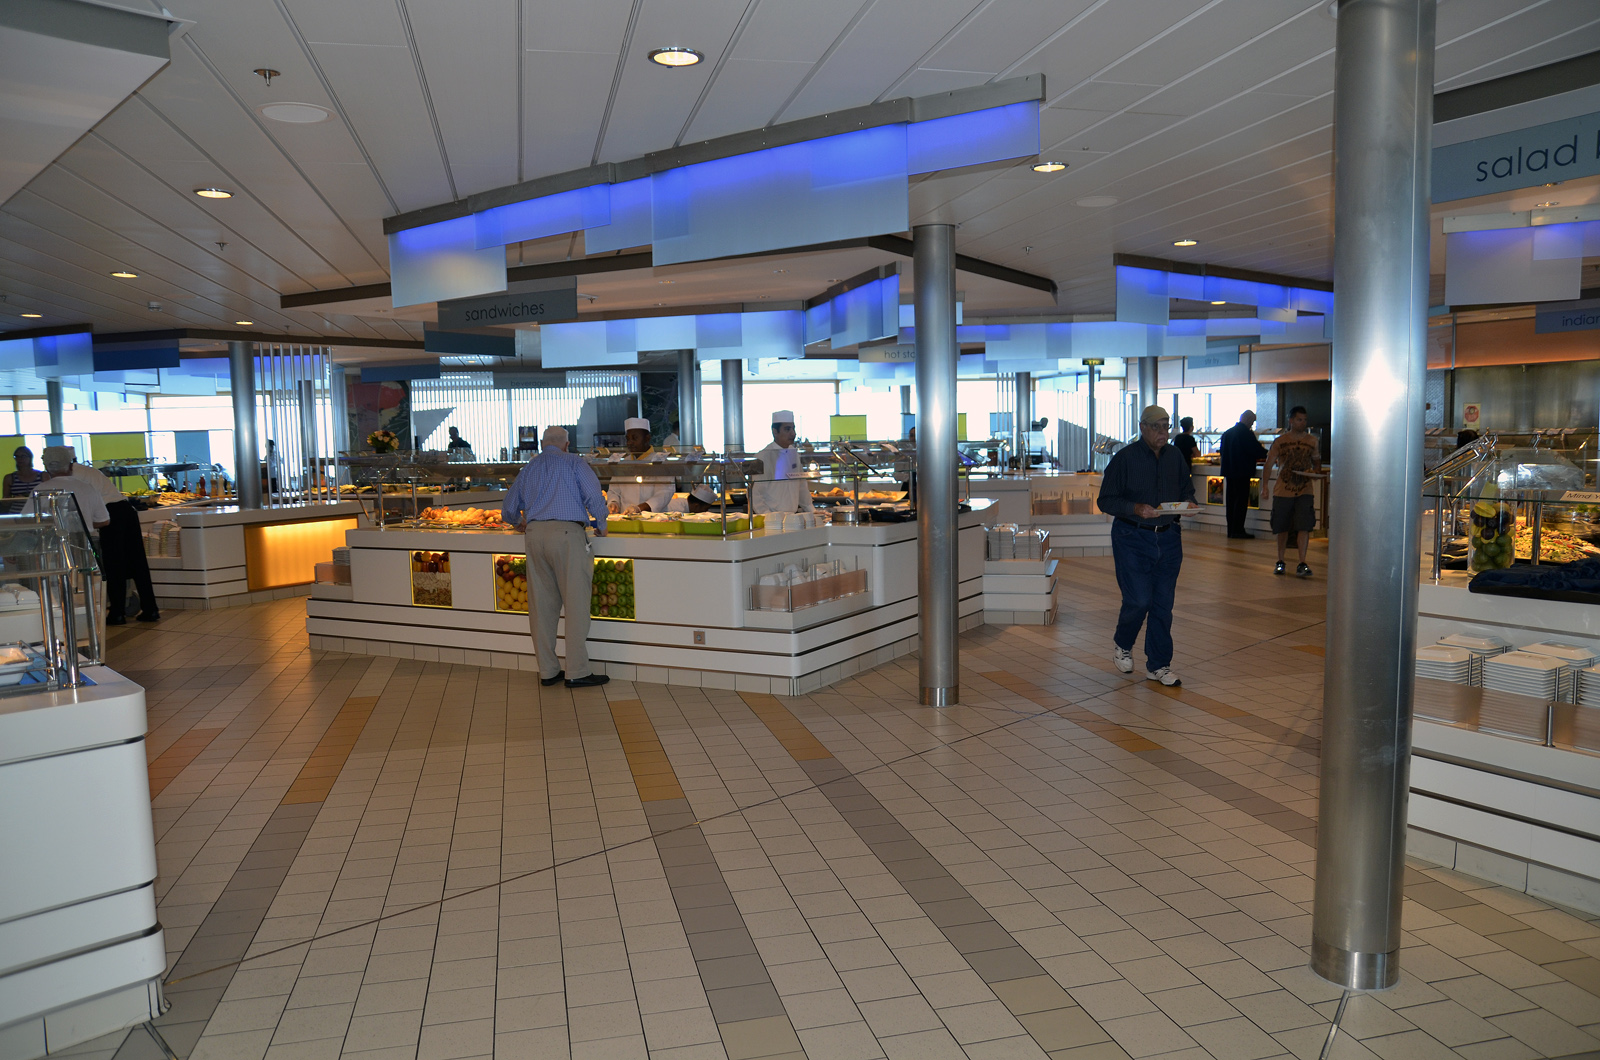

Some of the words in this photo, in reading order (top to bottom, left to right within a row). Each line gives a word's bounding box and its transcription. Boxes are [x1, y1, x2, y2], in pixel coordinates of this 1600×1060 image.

[1476, 134, 1578, 182] salad
[465, 302, 545, 321] sandwiches
[884, 349, 900, 359] hot
[510, 380, 550, 388] beverages
